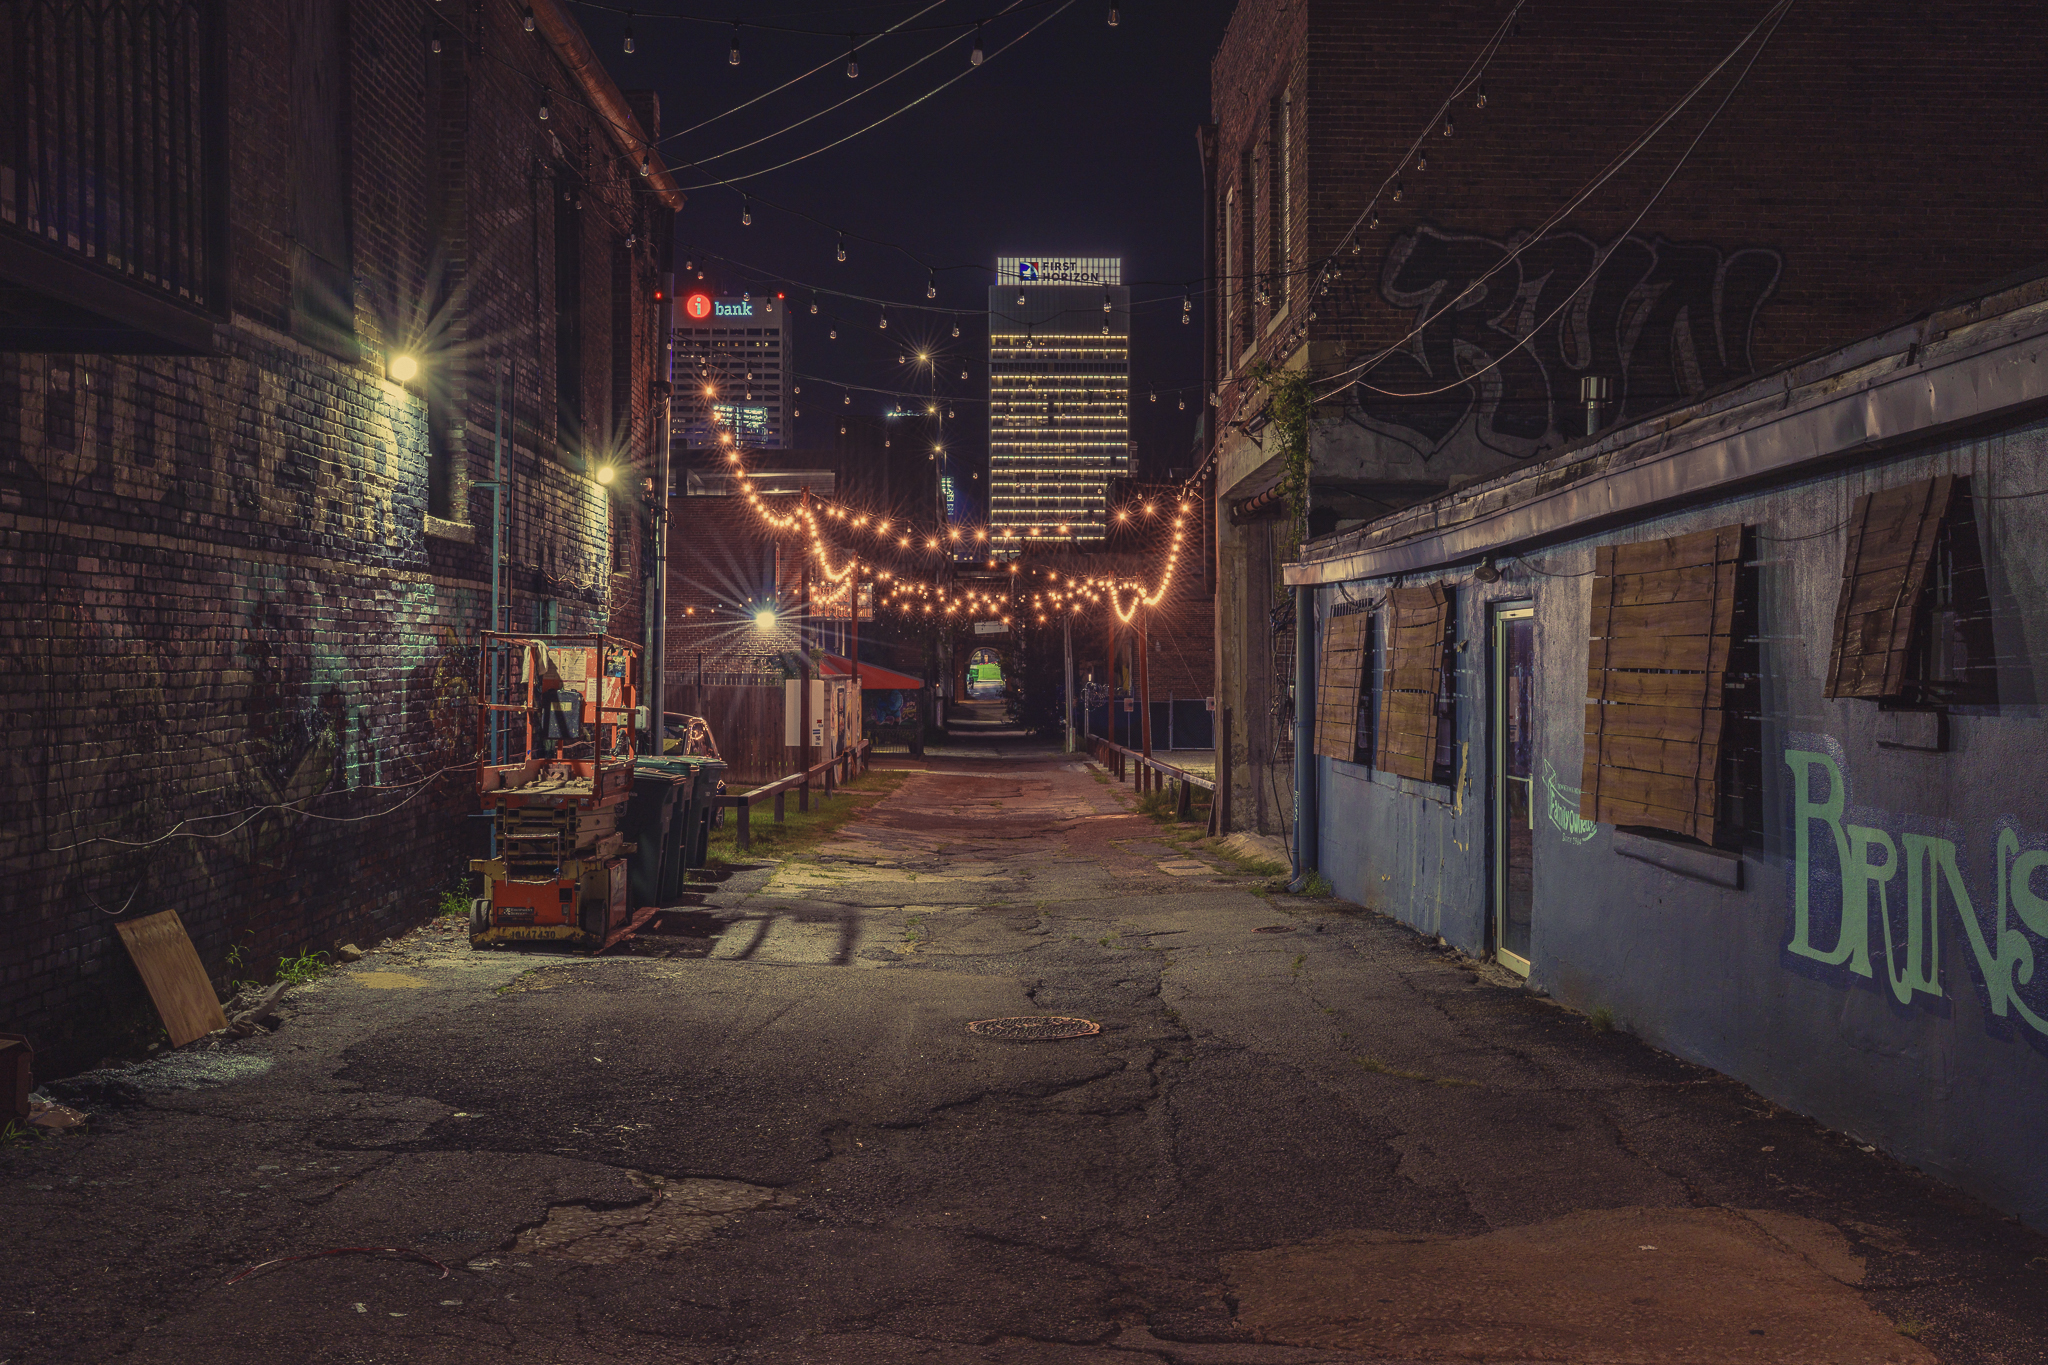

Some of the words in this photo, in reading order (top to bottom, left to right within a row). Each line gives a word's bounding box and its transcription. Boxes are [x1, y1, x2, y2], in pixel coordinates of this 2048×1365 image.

[1042, 262, 1077, 271] FIRST
[1042, 272, 1099, 282] HORIZON
[714, 301, 753, 316] bank
